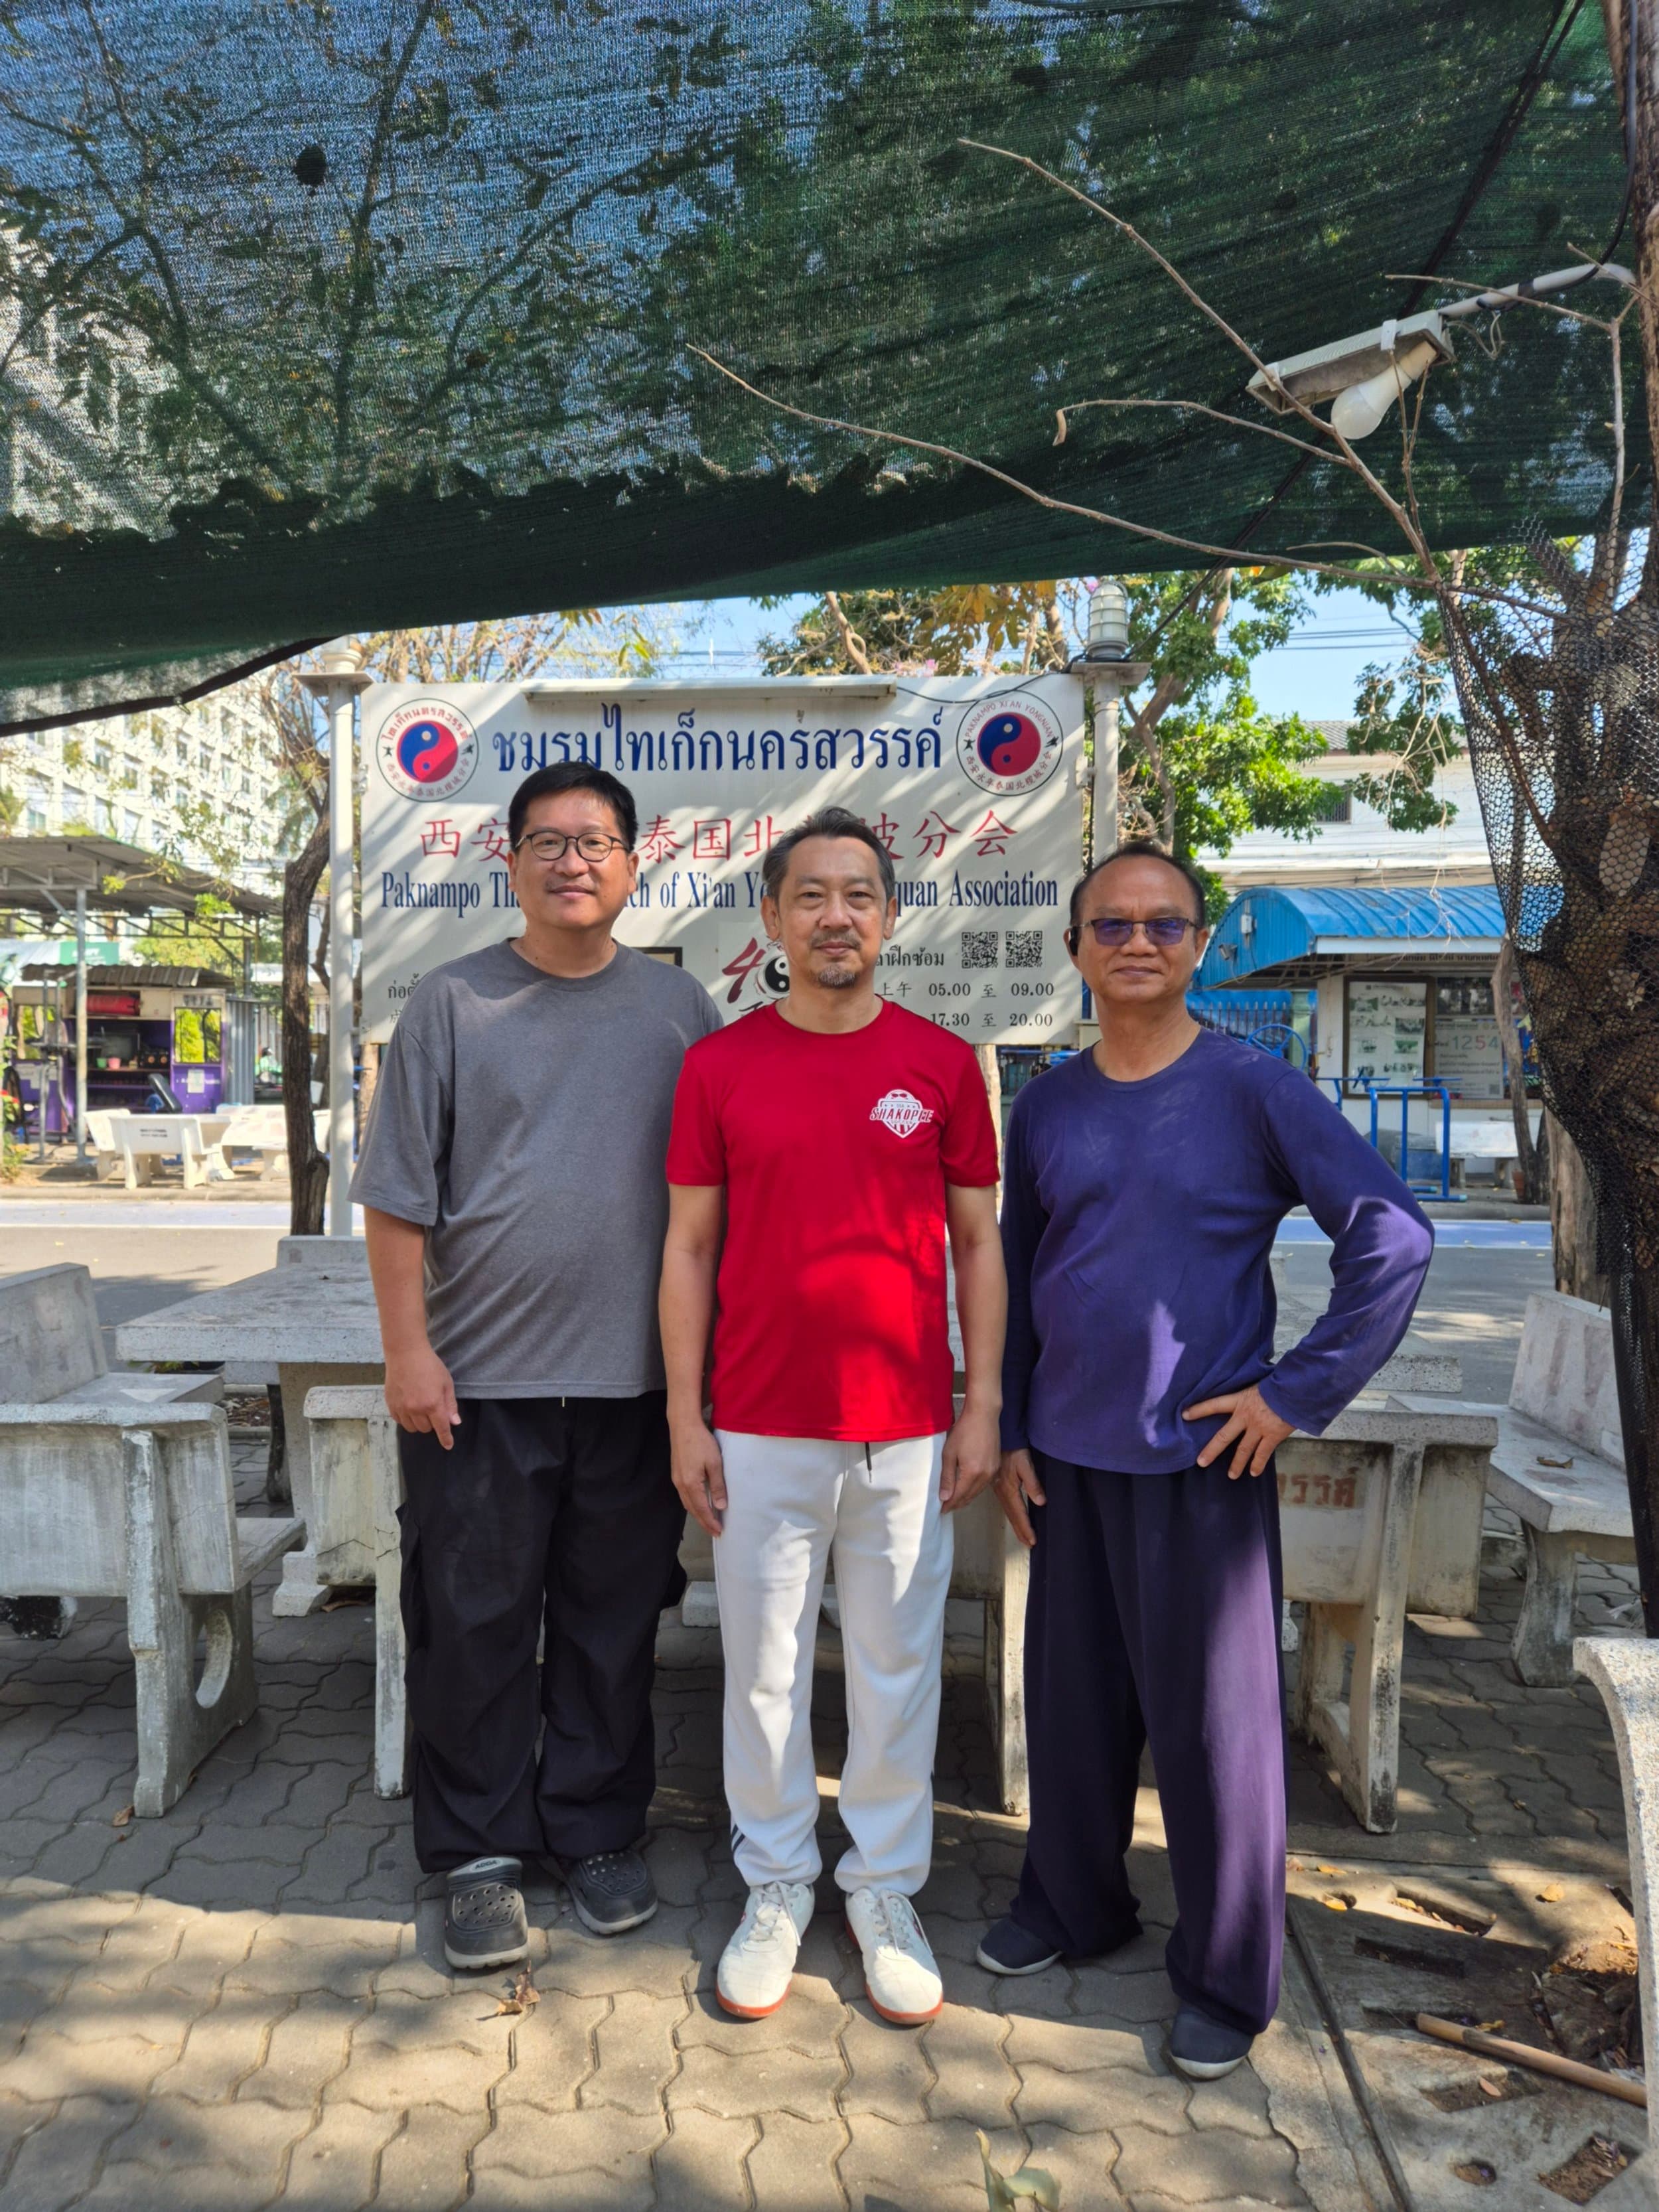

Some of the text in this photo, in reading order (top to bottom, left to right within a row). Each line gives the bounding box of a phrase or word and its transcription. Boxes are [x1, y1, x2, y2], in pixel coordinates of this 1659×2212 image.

[965, 702, 996, 738] PAKNAMPO
[1024, 702, 1054, 738] YONGNIAN
[492, 702, 942, 772] ชมรมไทเก็กนครสวรรค์
[381, 871, 480, 919] Paknampo
[489, 871, 521, 909] Th
[624, 871, 650, 908] ch
[660, 871, 680, 909] of
[687, 871, 736, 909] Xi'an
[949, 869, 1058, 907] Association
[928, 982, 971, 997] 05.00
[981, 983, 997, 999] 至
[1011, 982, 1054, 997] 09.00
[930, 1012, 1053, 1028] 17.30 至 20.00
[1452, 1035, 1498, 1051] 1254
[870, 1107, 934, 1122] SHAKOPEE
